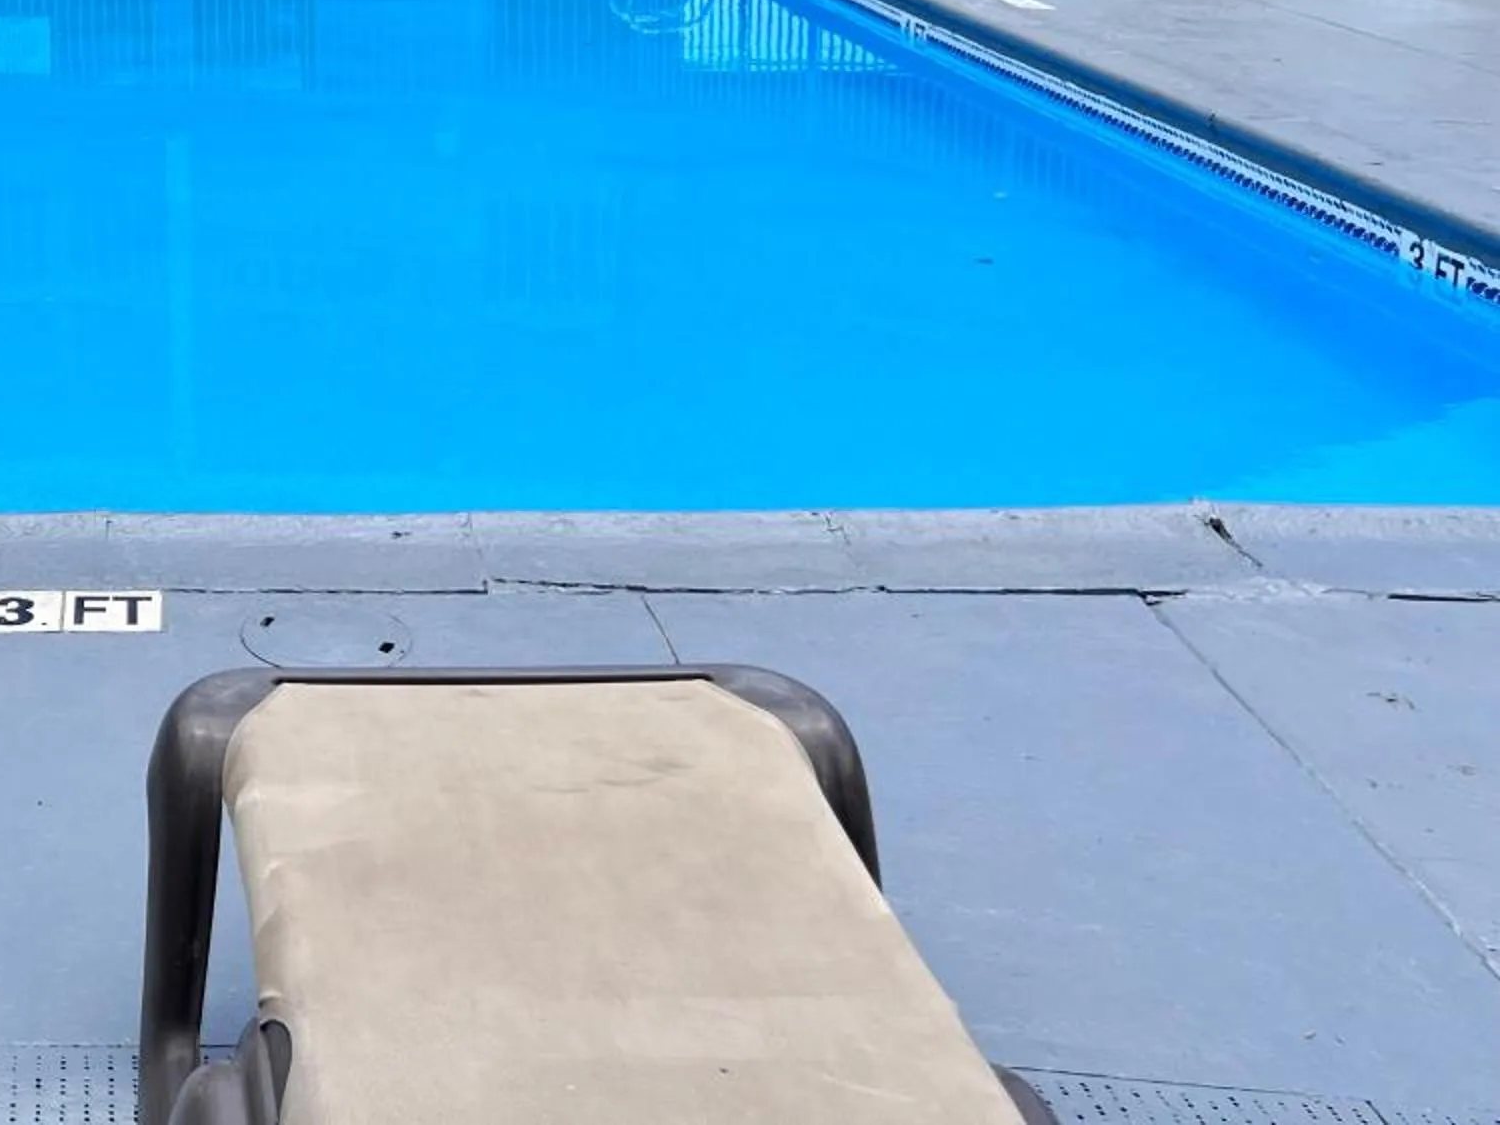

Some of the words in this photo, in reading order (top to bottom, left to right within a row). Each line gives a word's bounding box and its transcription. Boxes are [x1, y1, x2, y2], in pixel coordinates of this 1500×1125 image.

[1409, 241, 1424, 270] 3
[1435, 253, 1465, 288] FT
[73, 596, 153, 626] FT
